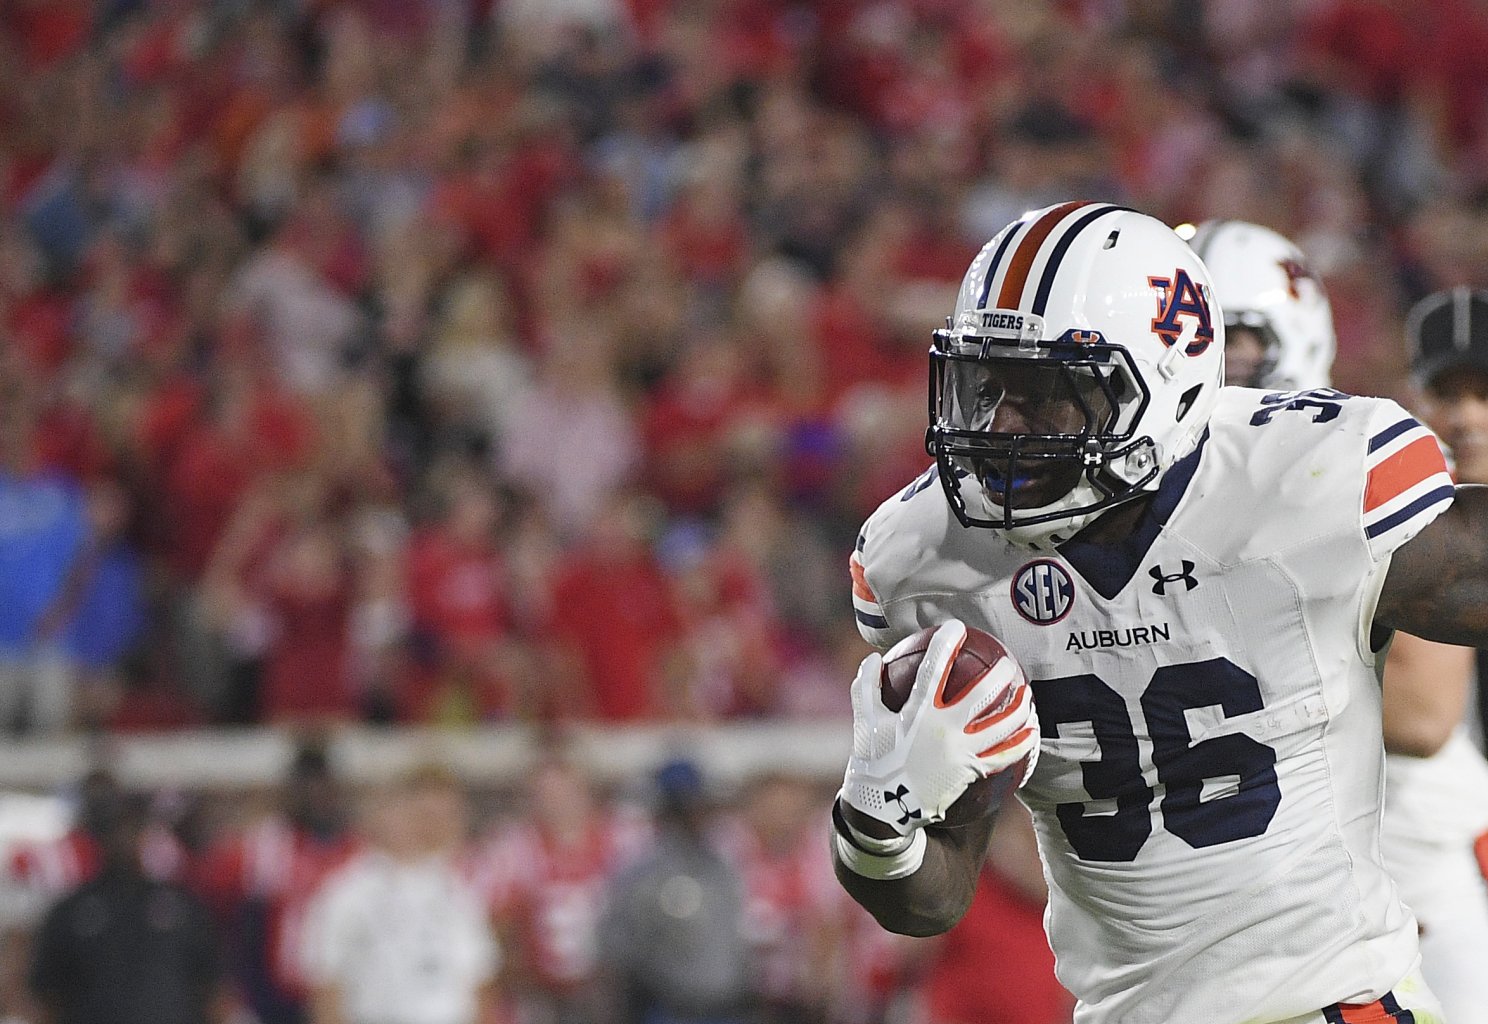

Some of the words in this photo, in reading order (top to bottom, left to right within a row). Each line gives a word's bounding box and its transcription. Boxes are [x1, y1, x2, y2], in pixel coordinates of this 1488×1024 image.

[982, 312, 1024, 330] TIGERS
[1016, 564, 1071, 620] SEC
[1066, 622, 1171, 651] AUBURN
[1030, 656, 1283, 862] 36
